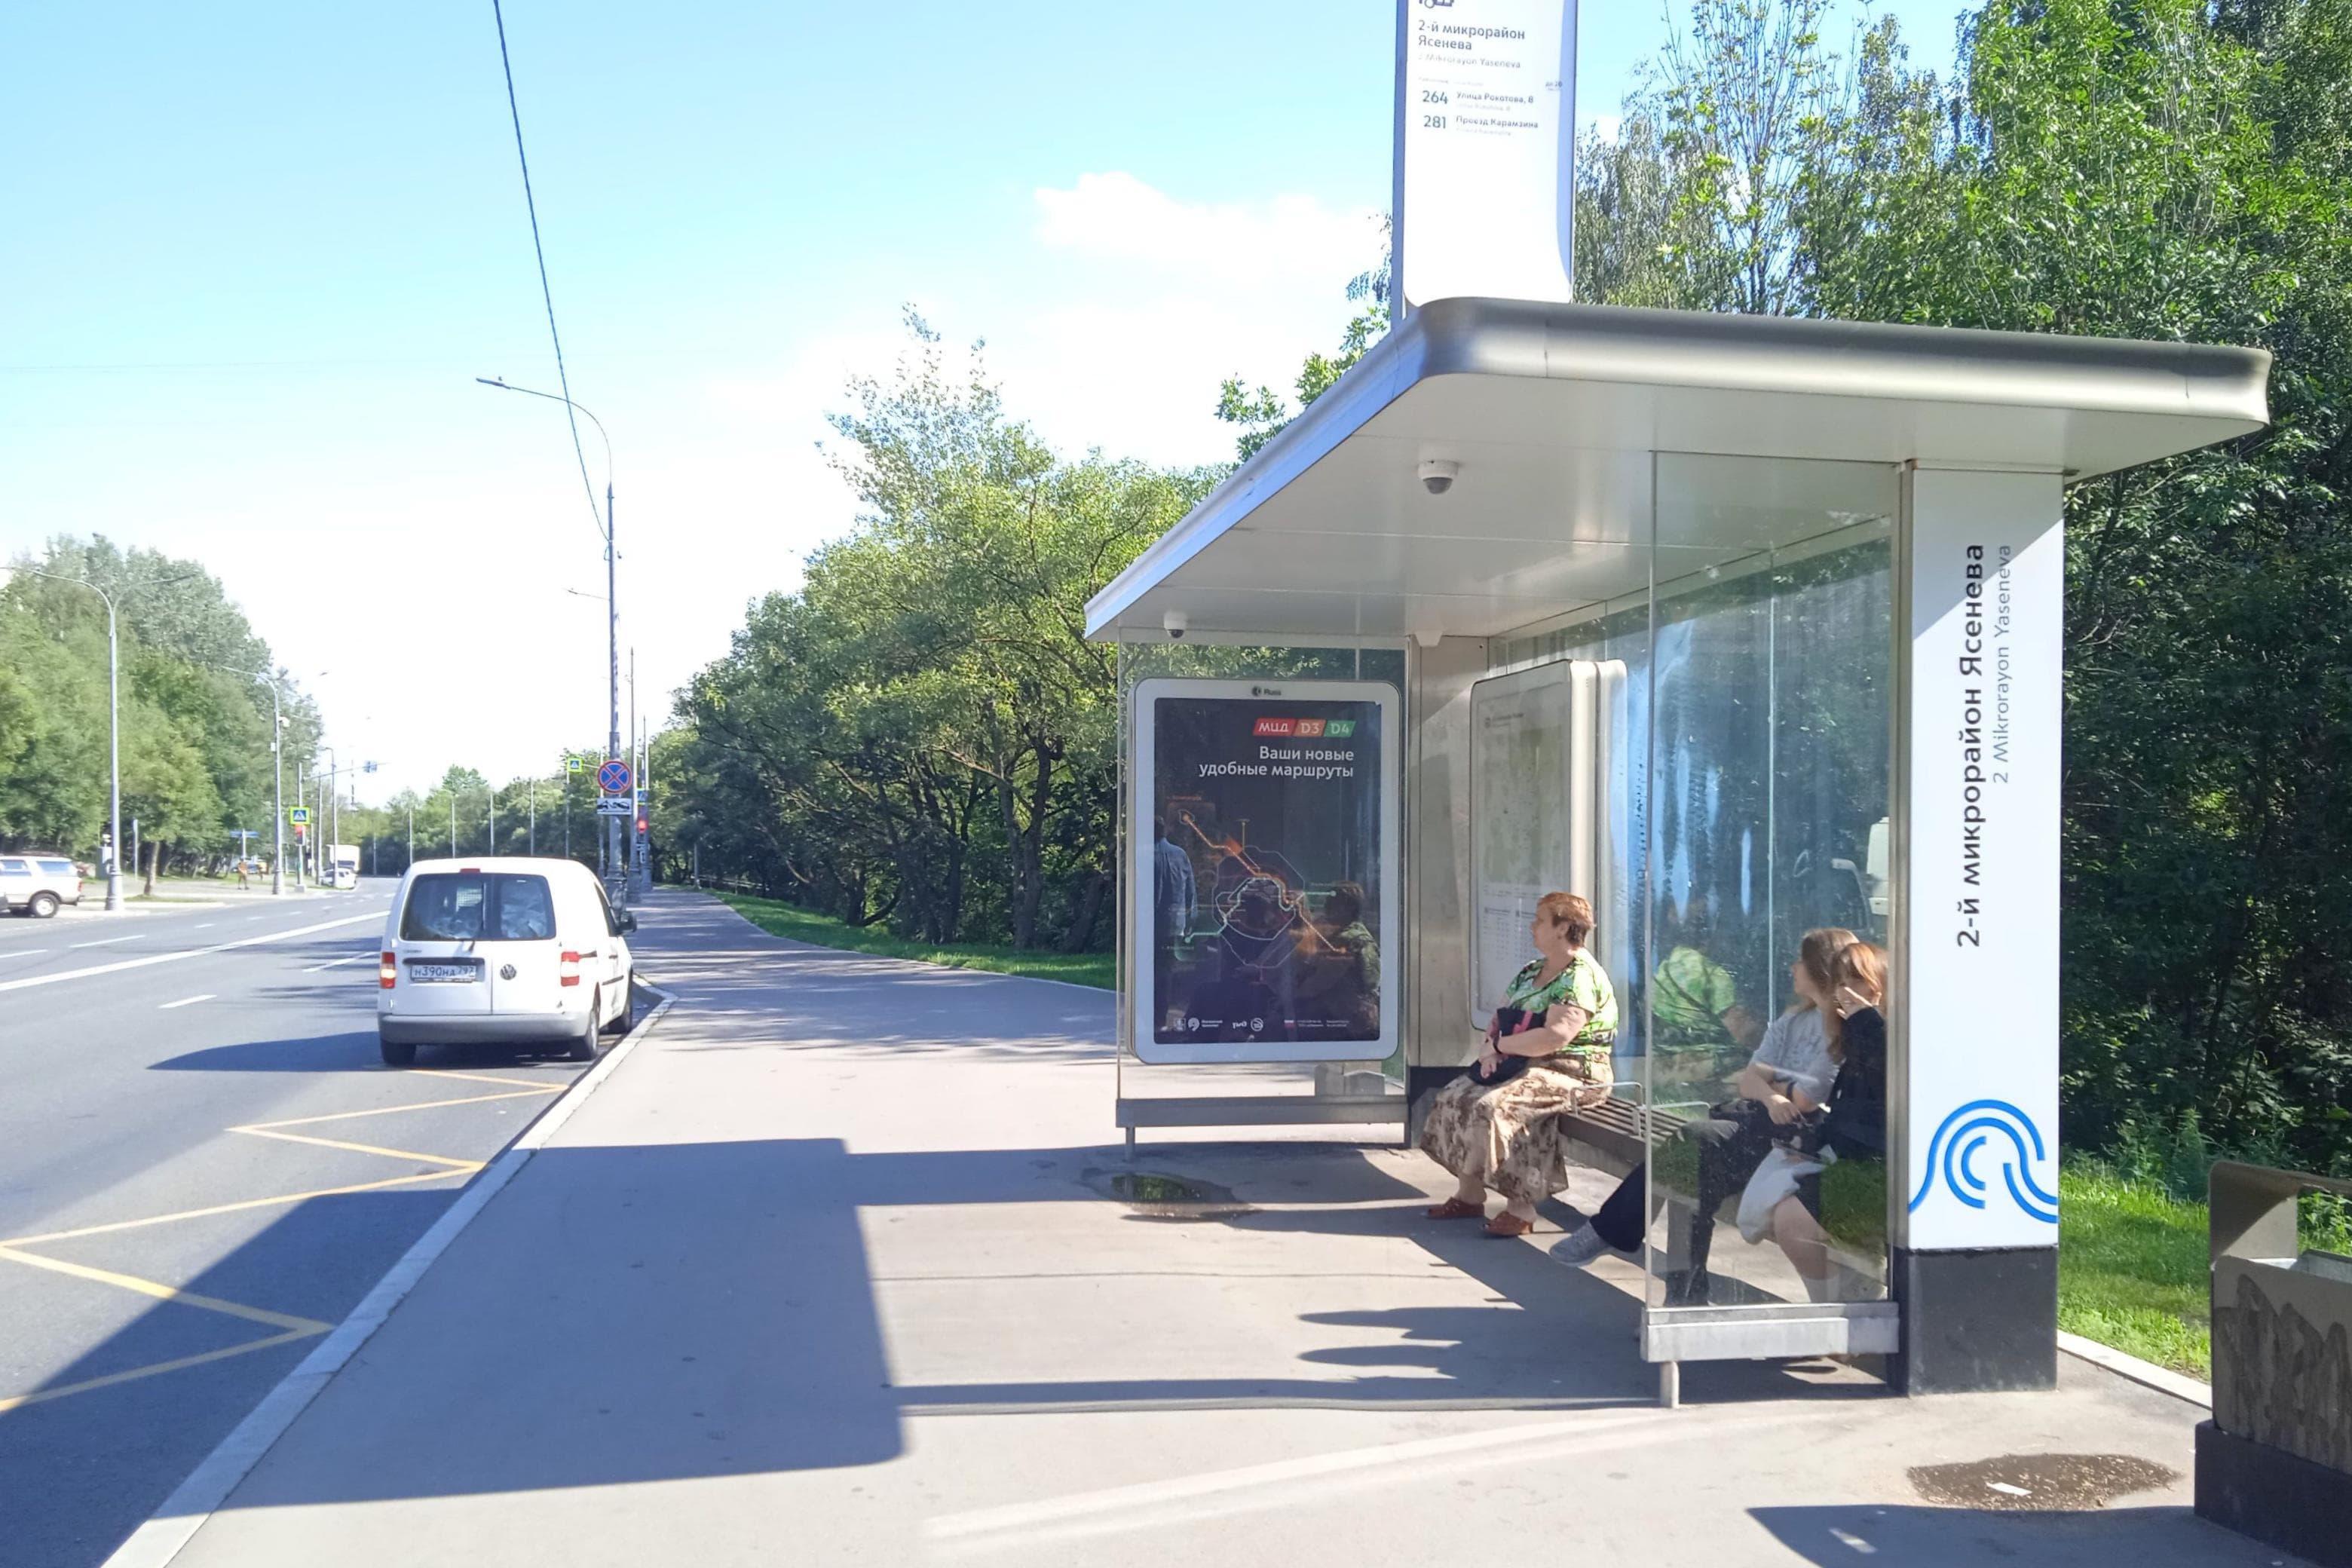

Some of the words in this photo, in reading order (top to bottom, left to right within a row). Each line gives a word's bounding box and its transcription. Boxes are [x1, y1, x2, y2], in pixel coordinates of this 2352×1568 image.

[1418, 20, 1439, 32] 2-й
[1442, 24, 1525, 40] микрорайон
[1418, 35, 1472, 51] Ясенева
[1480, 57, 1521, 69] Yaseneva
[1422, 90, 1448, 104] 264
[1456, 91, 1482, 101] Улица
[1484, 93, 1527, 104] Рокотова,
[1423, 115, 1447, 129] 281
[1456, 115, 1488, 126] Проезд
[1490, 118, 1539, 128] Карамзина
[1994, 544, 2011, 639] Yaseneva
[1959, 544, 1984, 676] Ясенева
[1992, 646, 2013, 763] Mikrorayon
[1258, 722, 1288, 733] МЦД
[1300, 723, 1320, 734] D3
[1331, 724, 1349, 734] D4
[1260, 746, 1300, 761] Ваши
[1306, 749, 1354, 761] новые
[1199, 761, 1268, 778] удобные
[1272, 764, 1354, 779] маршруты
[1992, 772, 2008, 784] 2
[1959, 688, 1986, 887] микрорайон
[1957, 898, 1980, 948] 2-й
